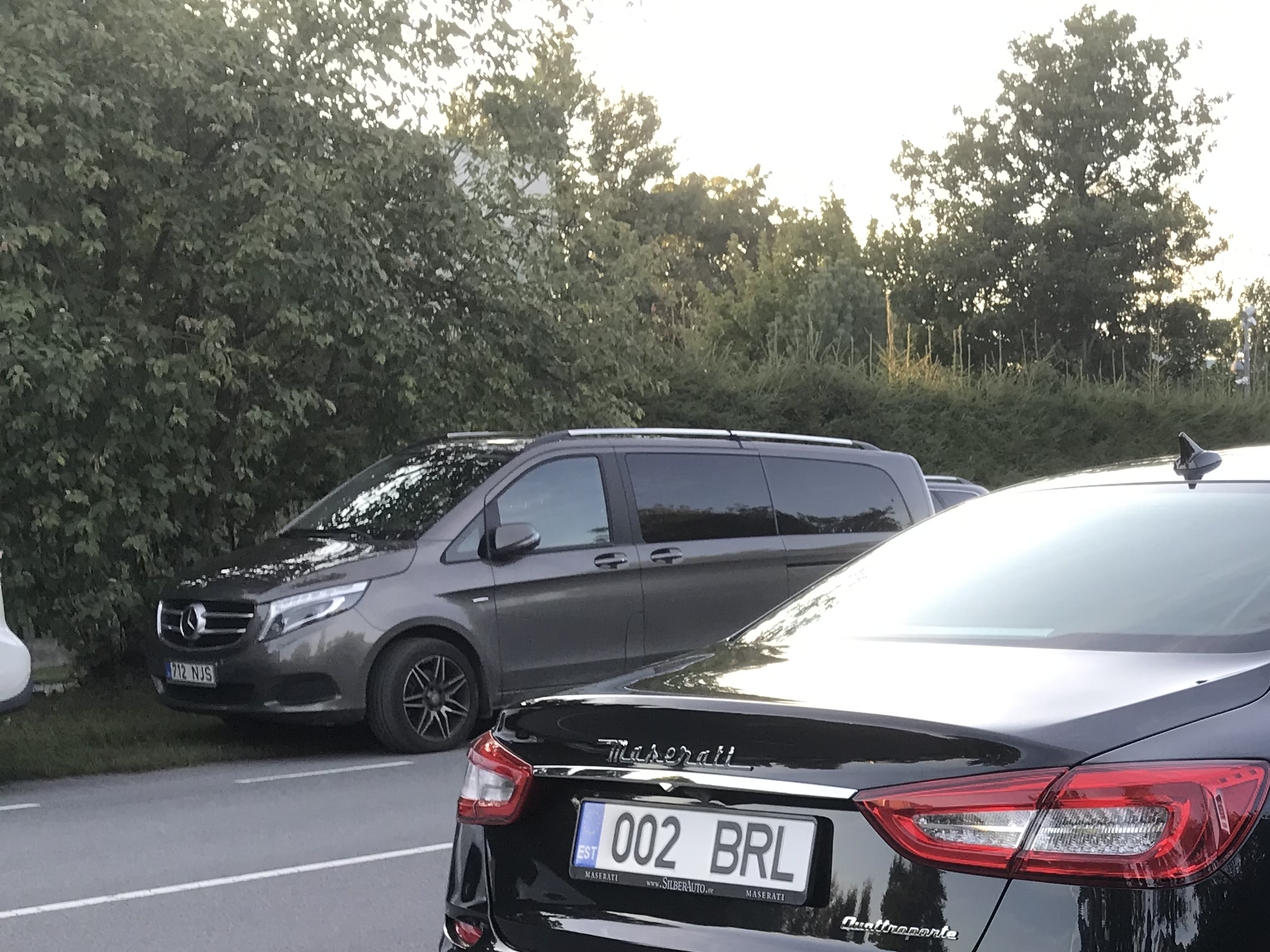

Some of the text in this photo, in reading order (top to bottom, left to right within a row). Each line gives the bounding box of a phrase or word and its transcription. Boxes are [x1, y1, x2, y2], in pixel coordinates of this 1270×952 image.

[172, 663, 187, 680] 712
[191, 665, 213, 682] NJS
[597, 738, 754, 772] Maserati
[576, 844, 598, 861] EST
[611, 811, 795, 883] 002 BRL
[584, 870, 619, 883] MASERATI
[745, 889, 786, 902] MASERATI
[840, 915, 959, 941] Quattroporte
